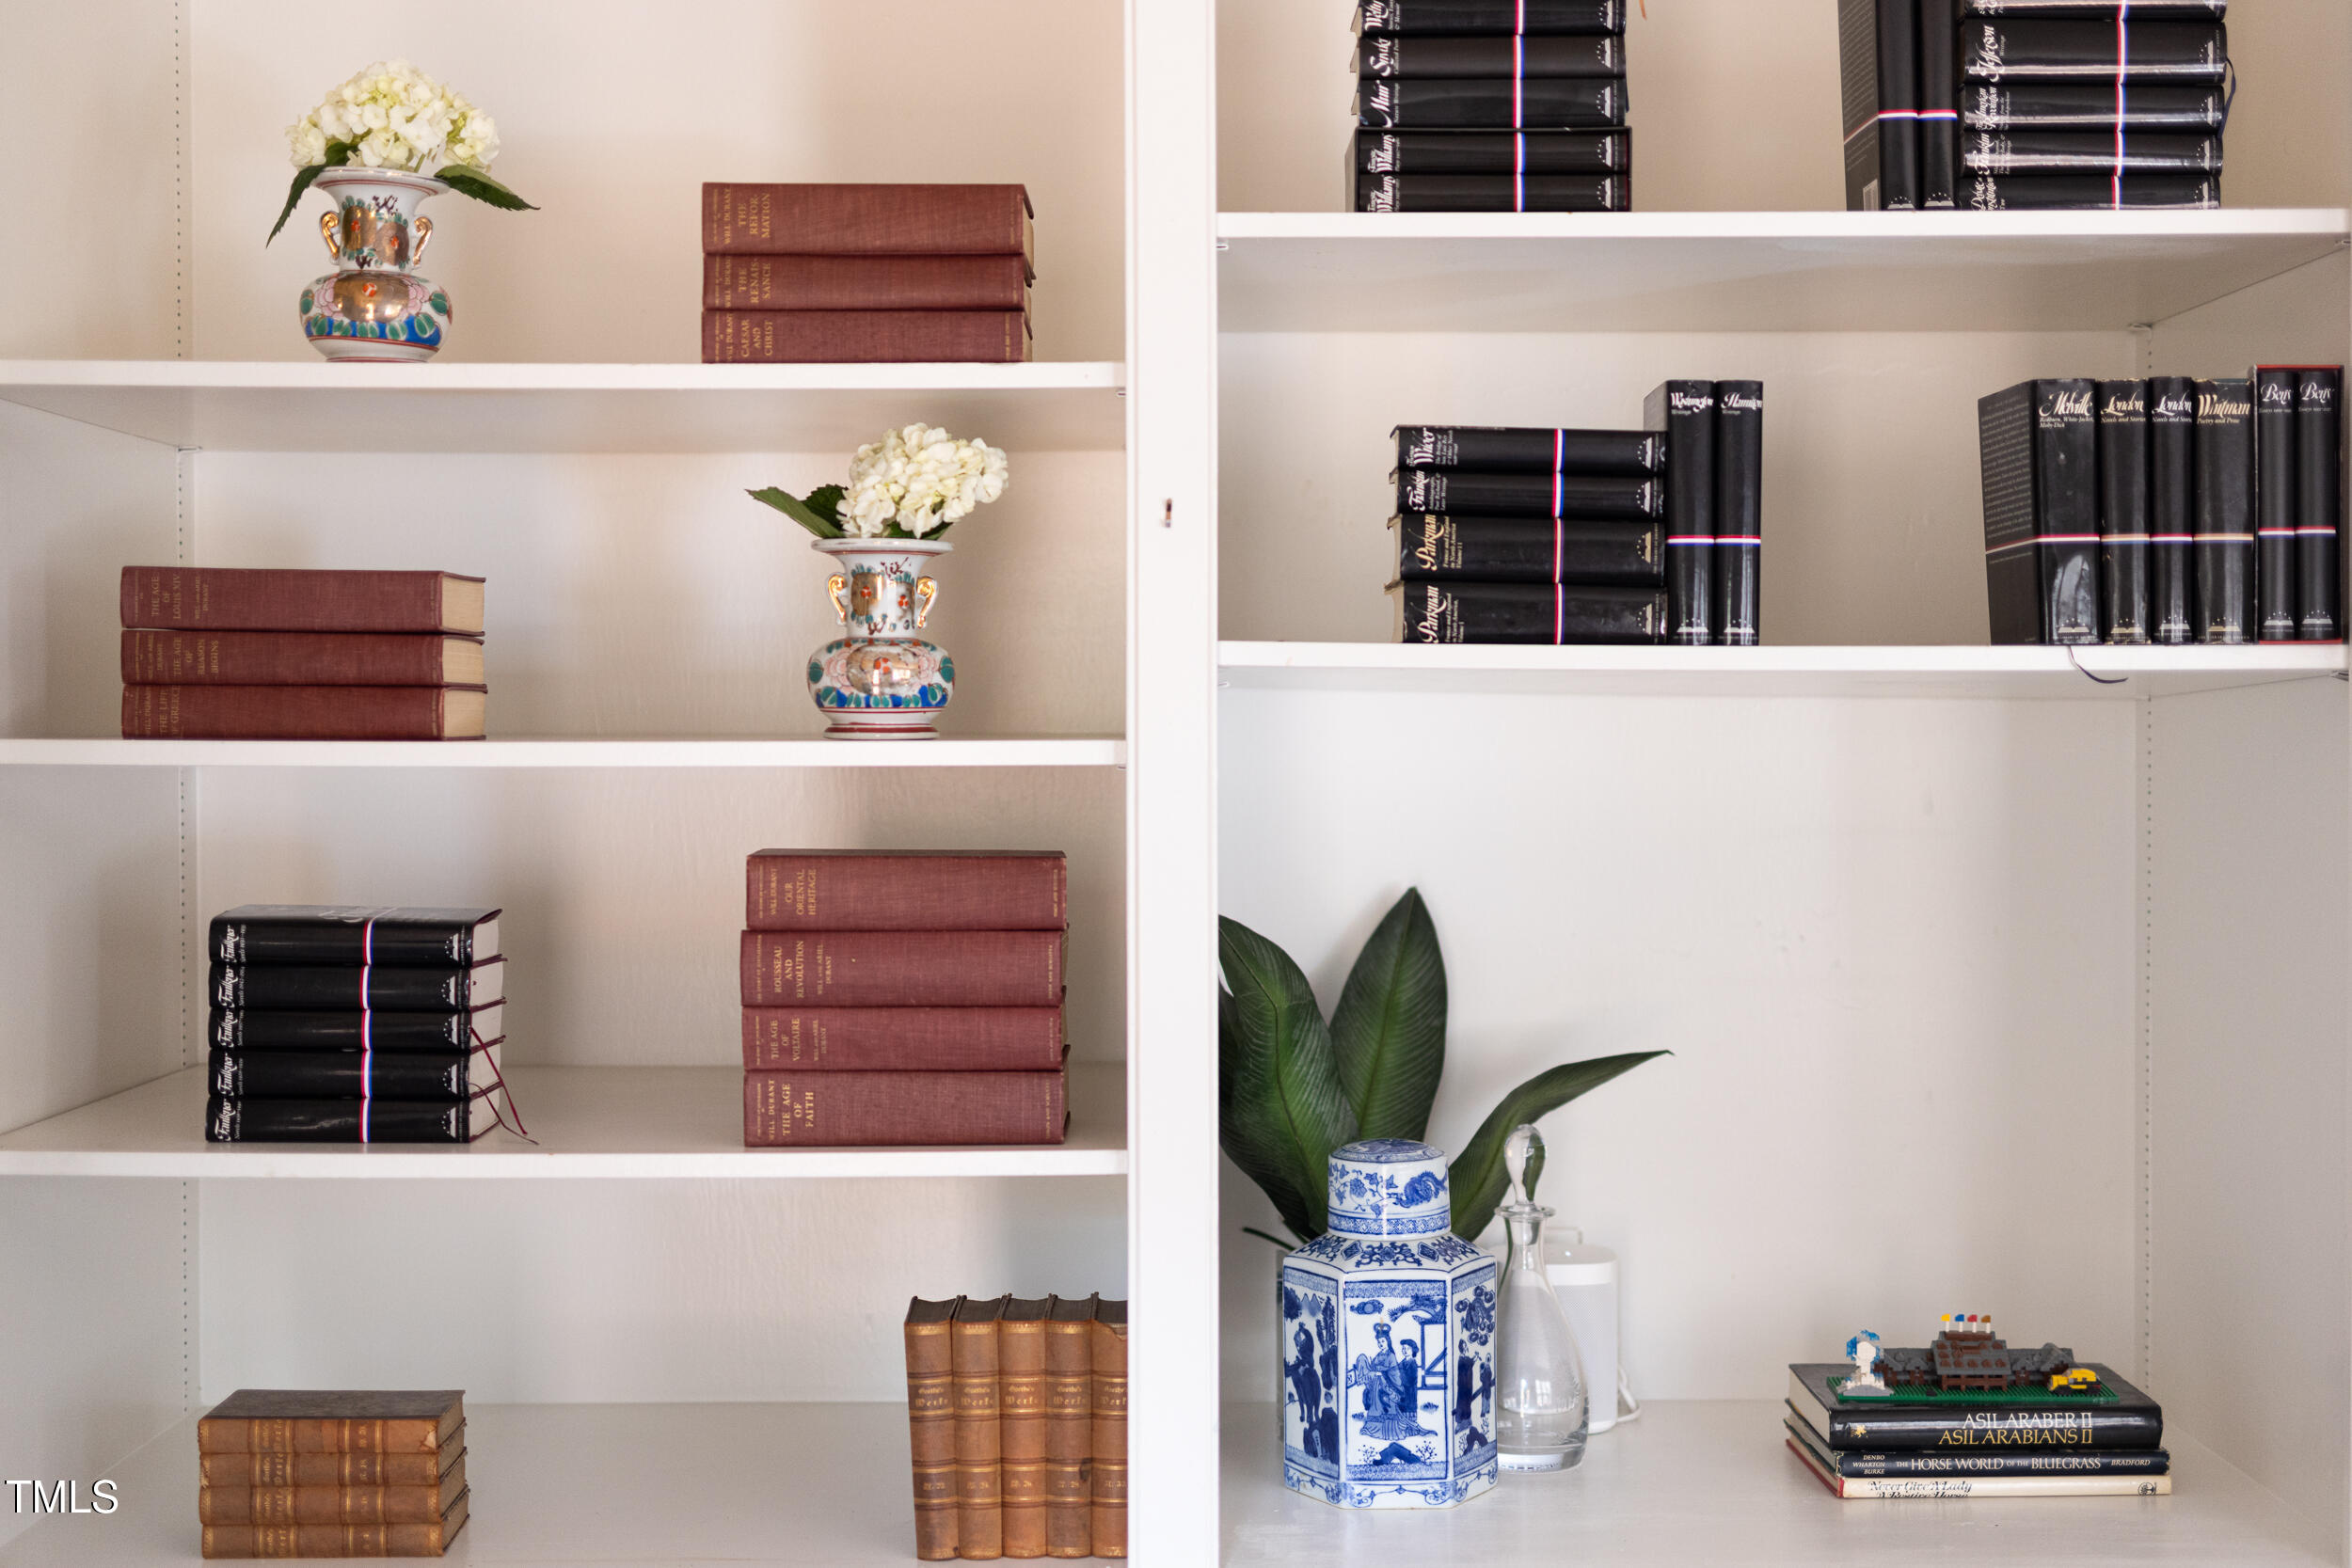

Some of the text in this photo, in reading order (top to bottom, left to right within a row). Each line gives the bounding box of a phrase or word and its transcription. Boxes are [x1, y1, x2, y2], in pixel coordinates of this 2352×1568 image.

[1976, 25, 2002, 82] Jefferson
[738, 203, 746, 226] THE
[750, 194, 758, 233] REFOR-
[761, 193, 770, 238] MATION
[739, 267, 747, 292] THE
[750, 259, 759, 303] RENAIS-
[762, 263, 771, 299] SANCE
[741, 319, 750, 357] CAESAR
[752, 326, 761, 348] AND
[764, 321, 772, 356] CHRIST
[2039, 390, 2094, 417] Melville
[2101, 390, 2144, 416] London
[2152, 390, 2192, 415] London
[2198, 393, 2250, 418] Whitman
[1406, 470, 1429, 511] Franklin
[1413, 515, 1444, 571] Parkman
[151, 576, 159, 617] THE AGE
[163, 591, 170, 602] OF
[1415, 585, 1446, 643] Parkman
[785, 882, 793, 903] OUR
[796, 867, 804, 915] ORIENTAL
[808, 868, 817, 915] HERITAGE
[220, 925, 239, 962] Faulkner
[218, 965, 238, 1007] Faulkner
[796, 941, 804, 998] REVOLUTION
[217, 1009, 238, 1047] Faulkner
[770, 1020, 779, 1059] THE AGE
[782, 1034, 789, 1046] OF
[791, 1017, 800, 1061] VOLTAIRE
[217, 1053, 237, 1096] Faulkner
[215, 1099, 235, 1141] Faulkner
[782, 1084, 790, 1136] THE AGE
[793, 1101, 803, 1118] OF
[805, 1091, 814, 1128] FAITH
[1938, 1430, 1979, 1445] ASIL
[1982, 1429, 2077, 1445] ARABIANS
[1963, 1413, 2003, 1429] ASIL
[2006, 1412, 2077, 1428] ARABER
[1911, 1458, 1952, 1470] HORSE
[1955, 1458, 2004, 1470] WORLD
[2031, 1458, 2101, 1469] BLUEGRASS
[1941, 1481, 1972, 1494] Lady
